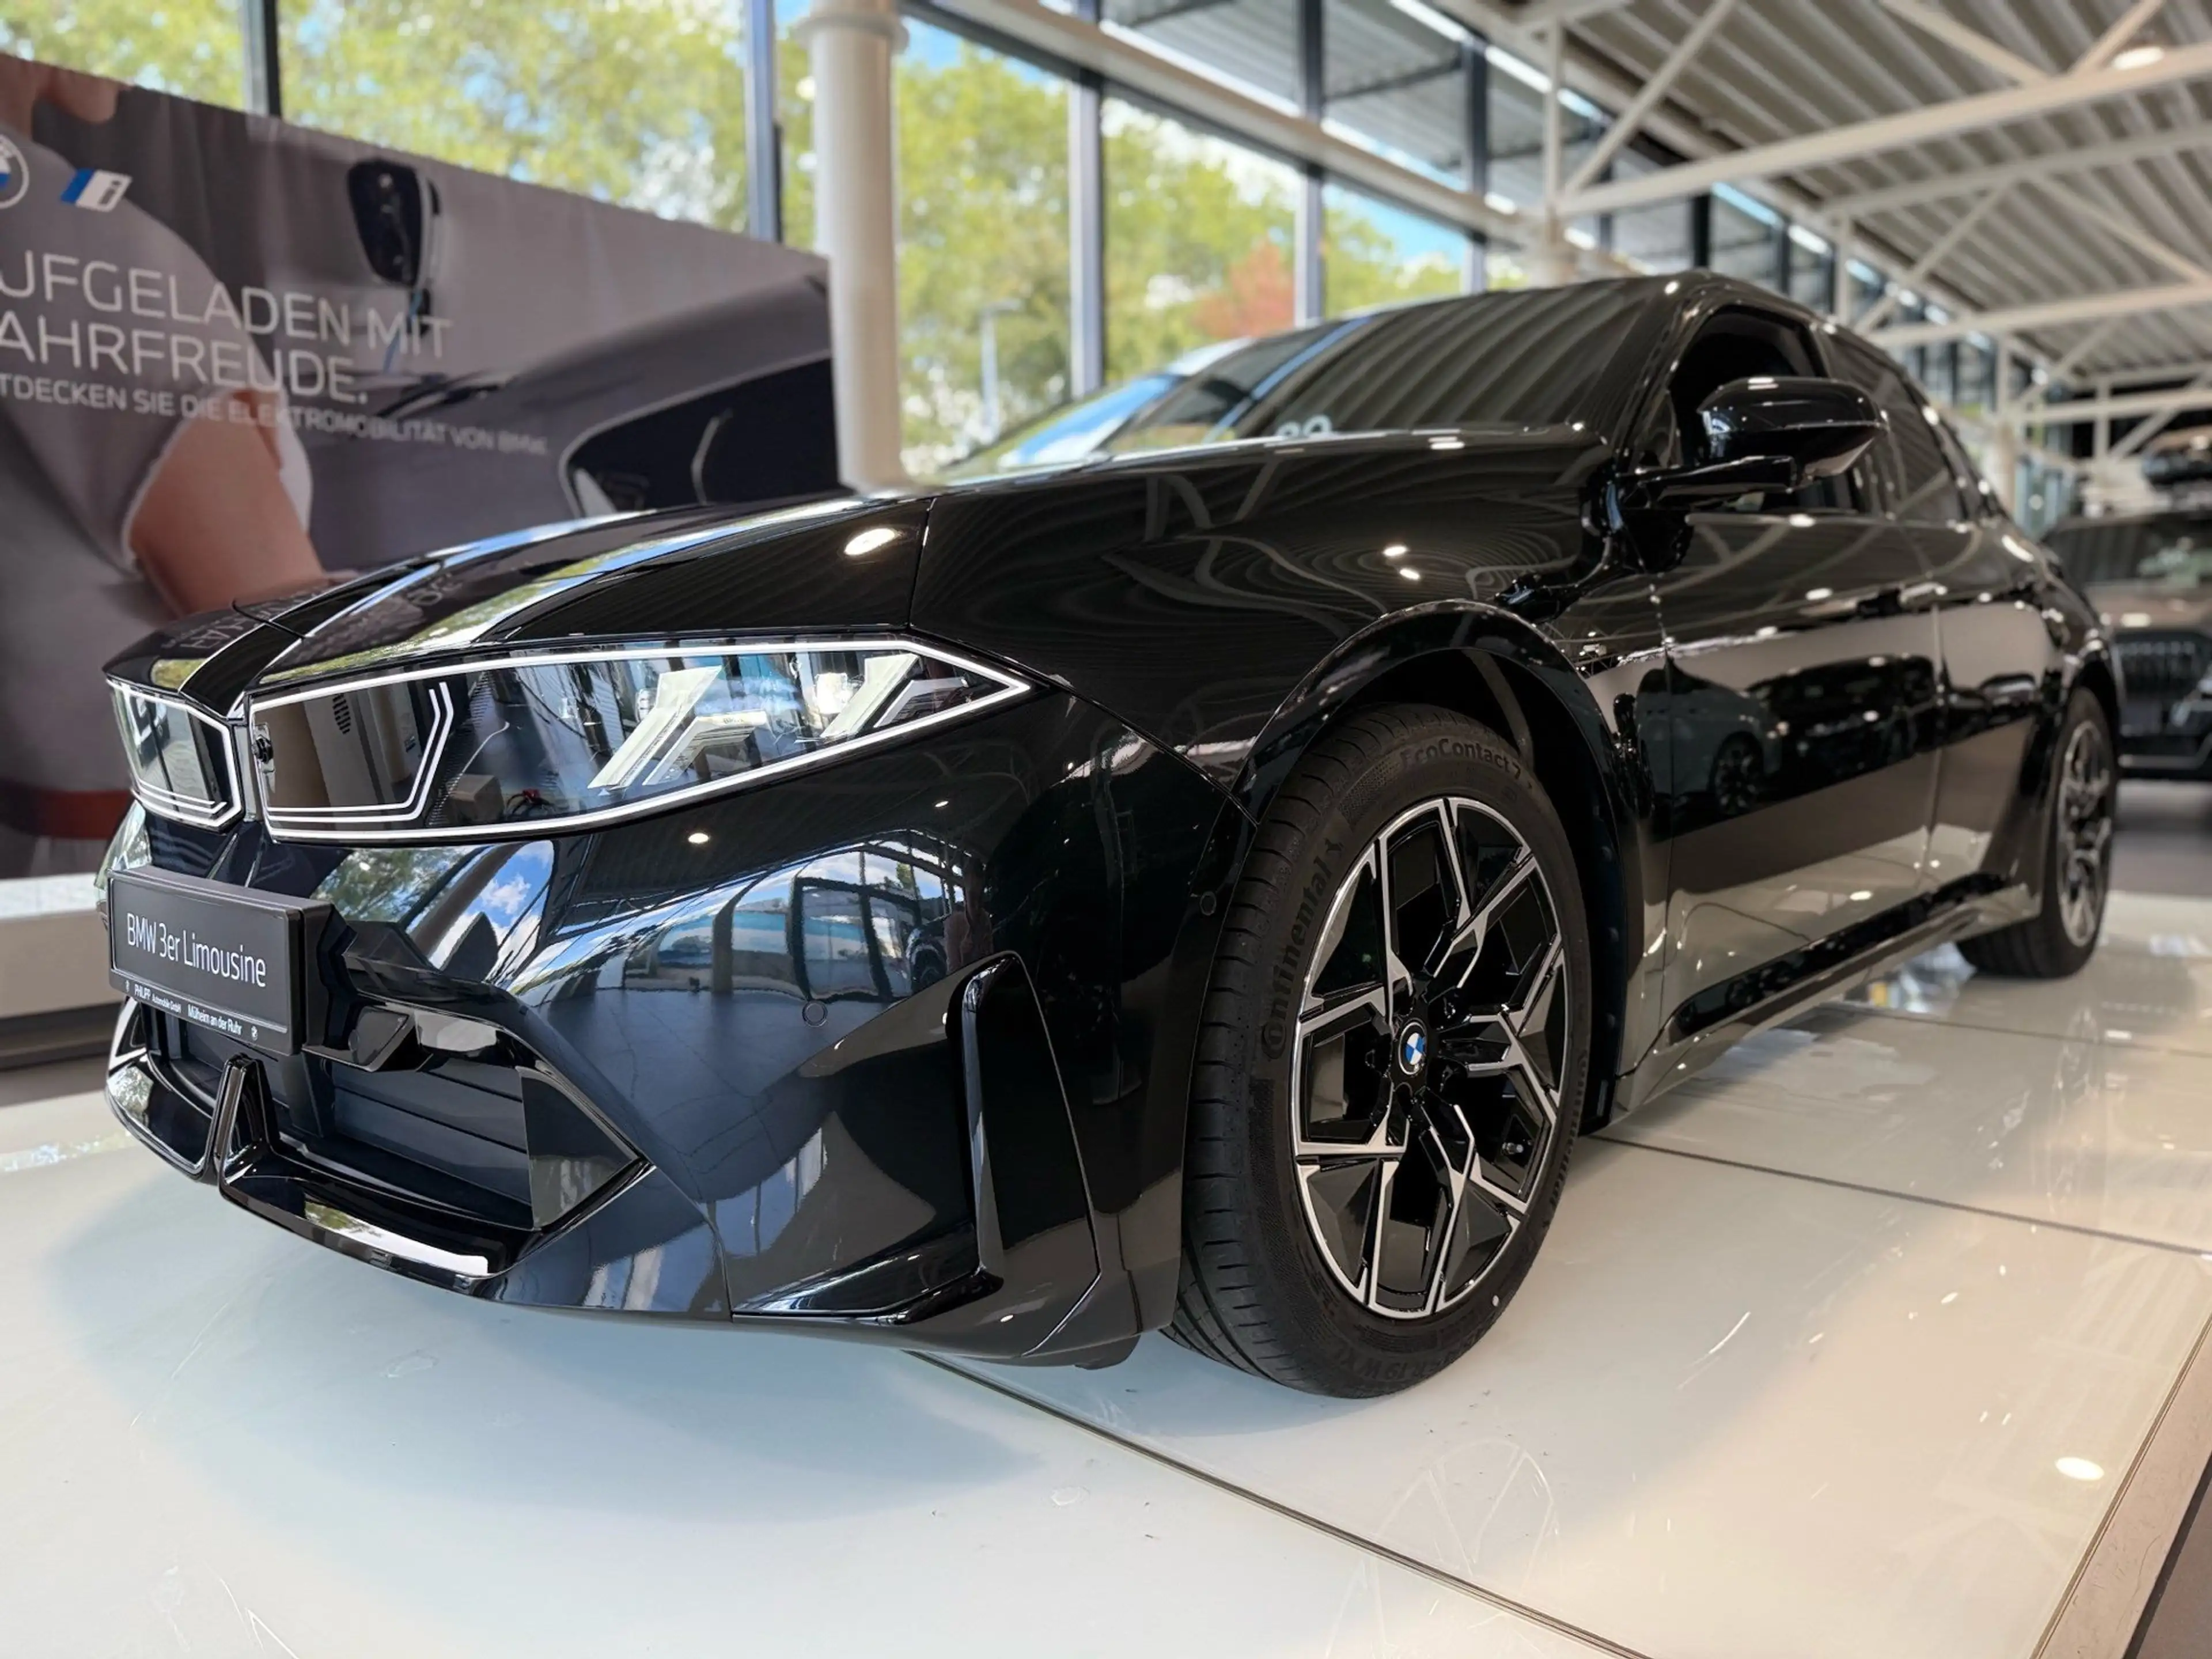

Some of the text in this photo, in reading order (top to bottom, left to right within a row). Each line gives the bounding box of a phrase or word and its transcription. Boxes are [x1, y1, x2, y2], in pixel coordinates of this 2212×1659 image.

[367, 308, 454, 359] MIT
[132, 388, 176, 416] SIE
[181, 395, 222, 422] DIE
[450, 425, 494, 451] VON
[1400, 738, 1510, 773] EcoContact
[127, 912, 267, 987] BMW 3er Limousine
[1261, 855, 1332, 1059] Continental
